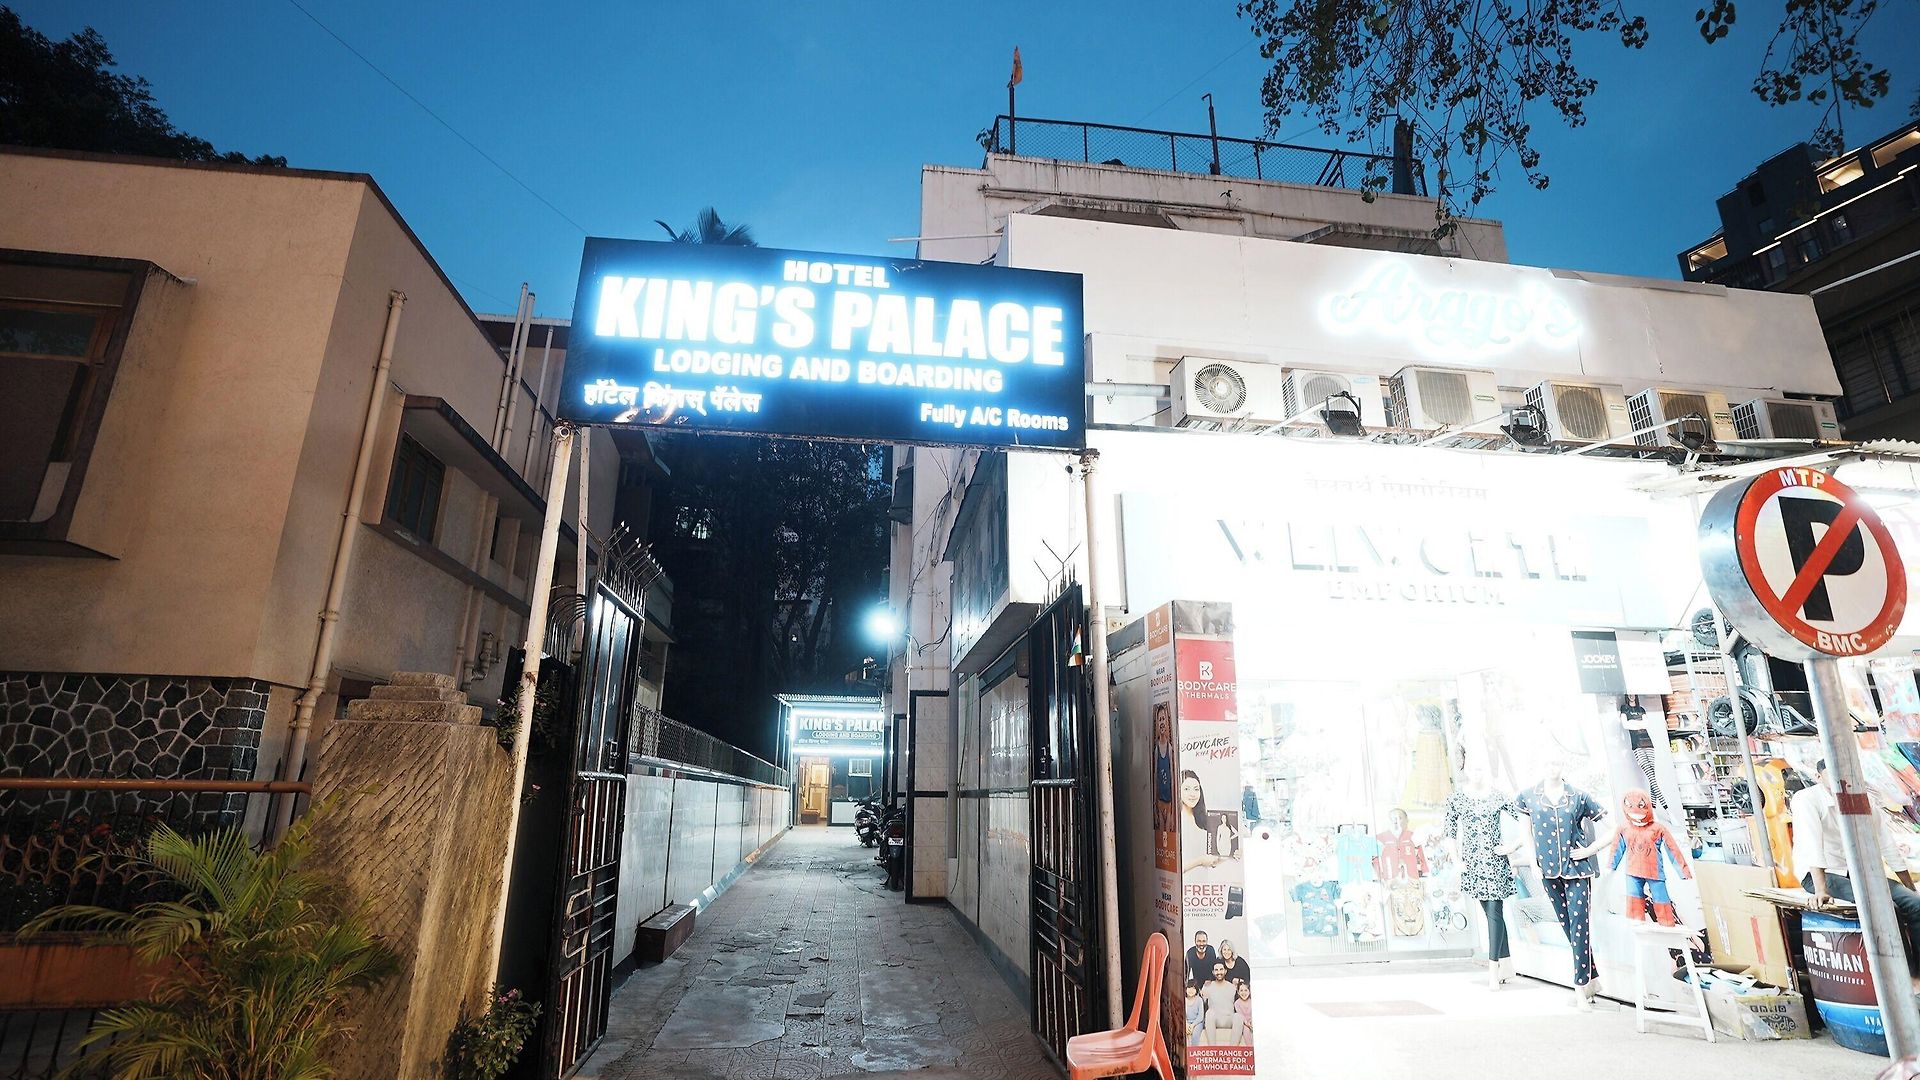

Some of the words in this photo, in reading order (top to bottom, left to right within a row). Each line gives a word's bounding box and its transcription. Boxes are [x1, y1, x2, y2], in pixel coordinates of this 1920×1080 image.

[784, 260, 889, 288] HOTEL
[595, 276, 814, 350] KING'S
[831, 291, 1064, 366] PALACE
[654, 348, 783, 379] LODGING
[789, 356, 850, 383] AND
[857, 360, 1002, 393] BOARDING
[583, 377, 639, 406] हॉटेल
[920, 402, 966, 430] Fully
[969, 407, 1002, 428] A/C
[1006, 410, 1069, 431] Rooms
[1778, 468, 1825, 488] MTP
[1816, 632, 1867, 654] BMC
[1581, 655, 1616, 664] JOCKEY
[1177, 681, 1237, 692] BODYCARE
[1185, 691, 1230, 700] THERMALS
[799, 717, 843, 731] KING'S
[1210, 746, 1238, 760] KYA?
[1184, 896, 1224, 907] SOCKS
